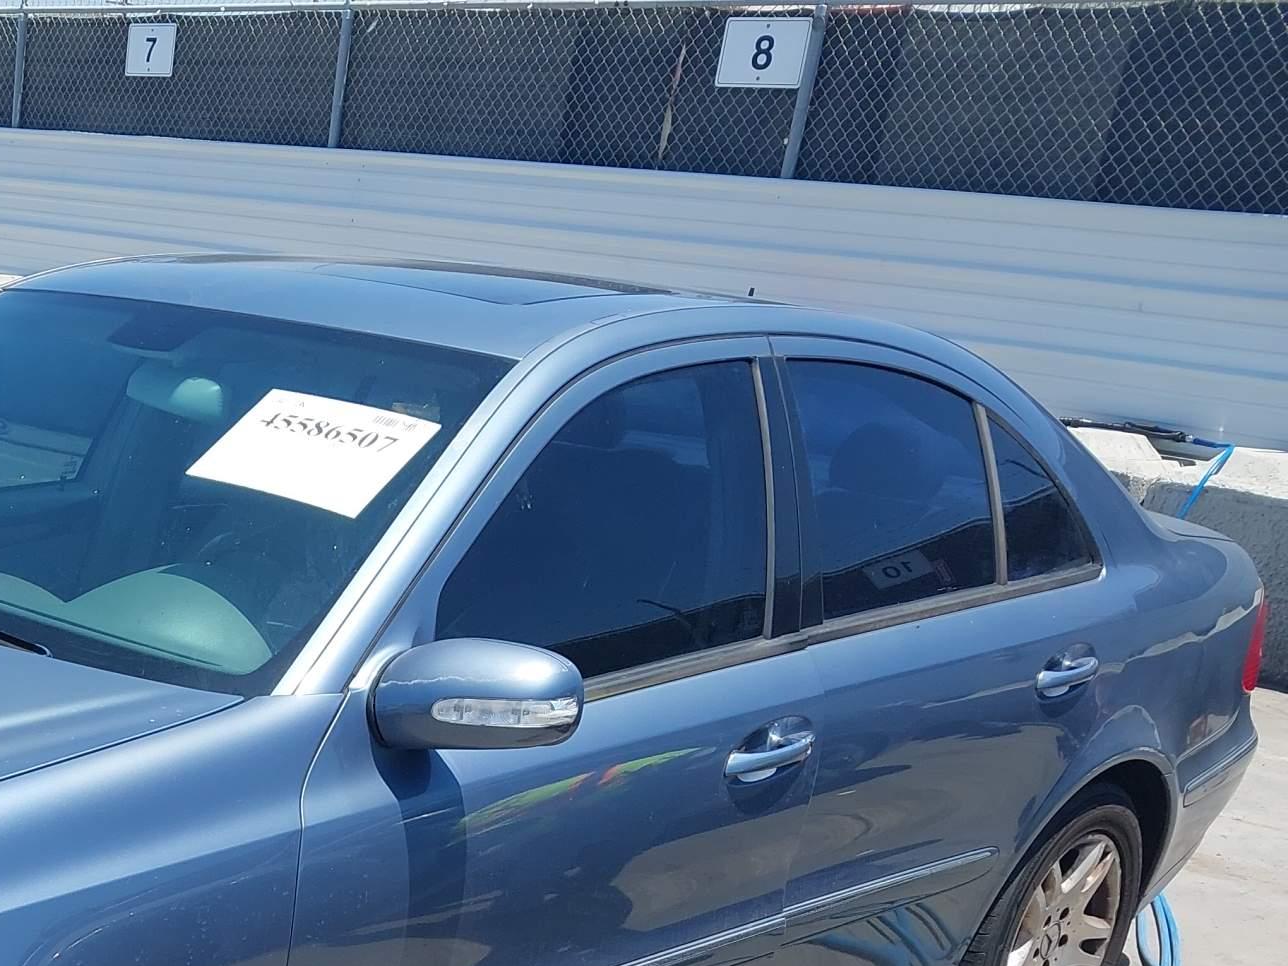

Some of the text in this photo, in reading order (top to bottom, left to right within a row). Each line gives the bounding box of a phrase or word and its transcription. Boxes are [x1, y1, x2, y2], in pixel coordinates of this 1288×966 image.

[146, 37, 157, 62] 7
[751, 35, 774, 70] 8
[260, 412, 399, 452] 45586507
